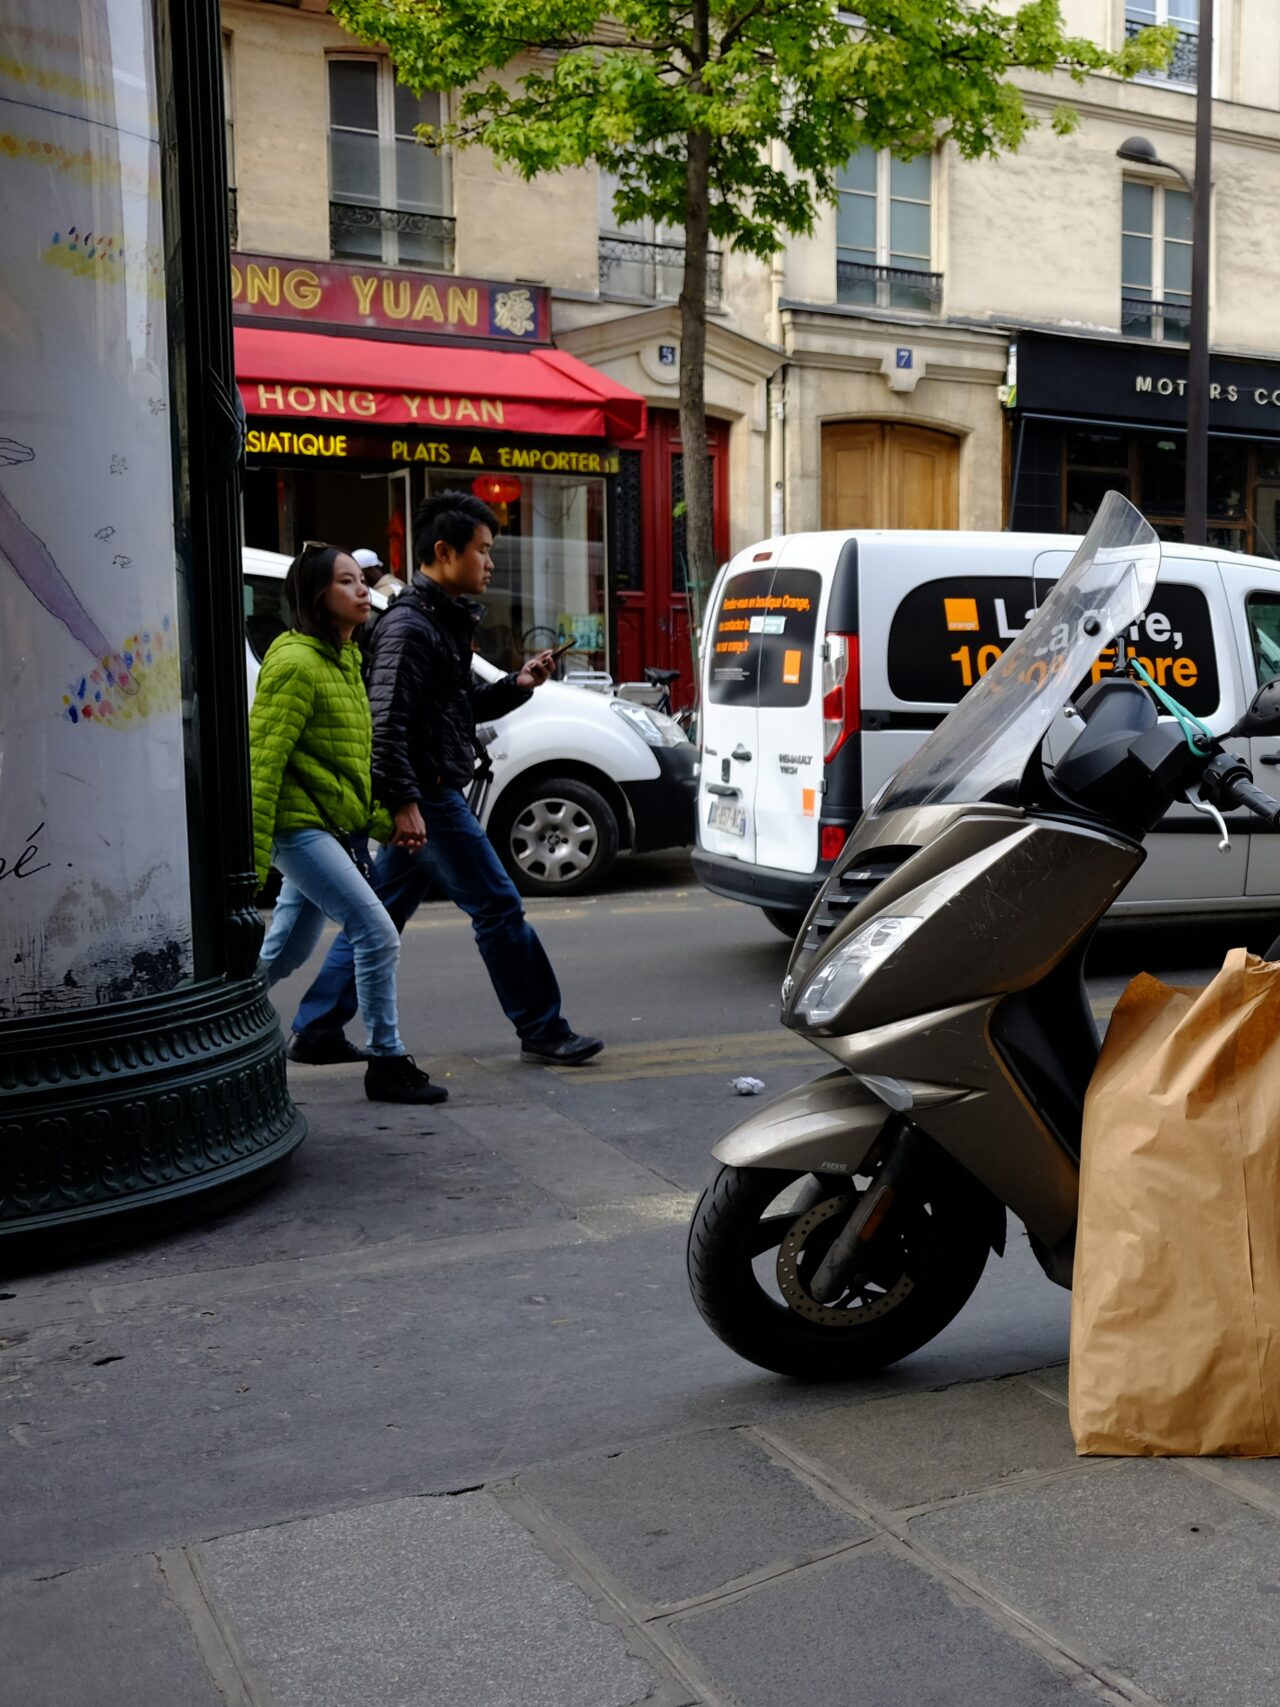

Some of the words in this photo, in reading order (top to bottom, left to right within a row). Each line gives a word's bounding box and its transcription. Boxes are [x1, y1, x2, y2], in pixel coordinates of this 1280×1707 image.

[231, 263, 322, 310] NG
[352, 275, 479, 327] YUAN
[661, 347, 673, 364] 5
[899, 351, 910, 367] 7
[1135, 376, 1239, 402] MOTRS
[257, 384, 377, 416] HONG
[402, 395, 505, 425] YUAN
[391, 440, 451, 464] PLATS
[468, 445, 484, 465] A
[1091, 646, 1198, 688] Fbre
